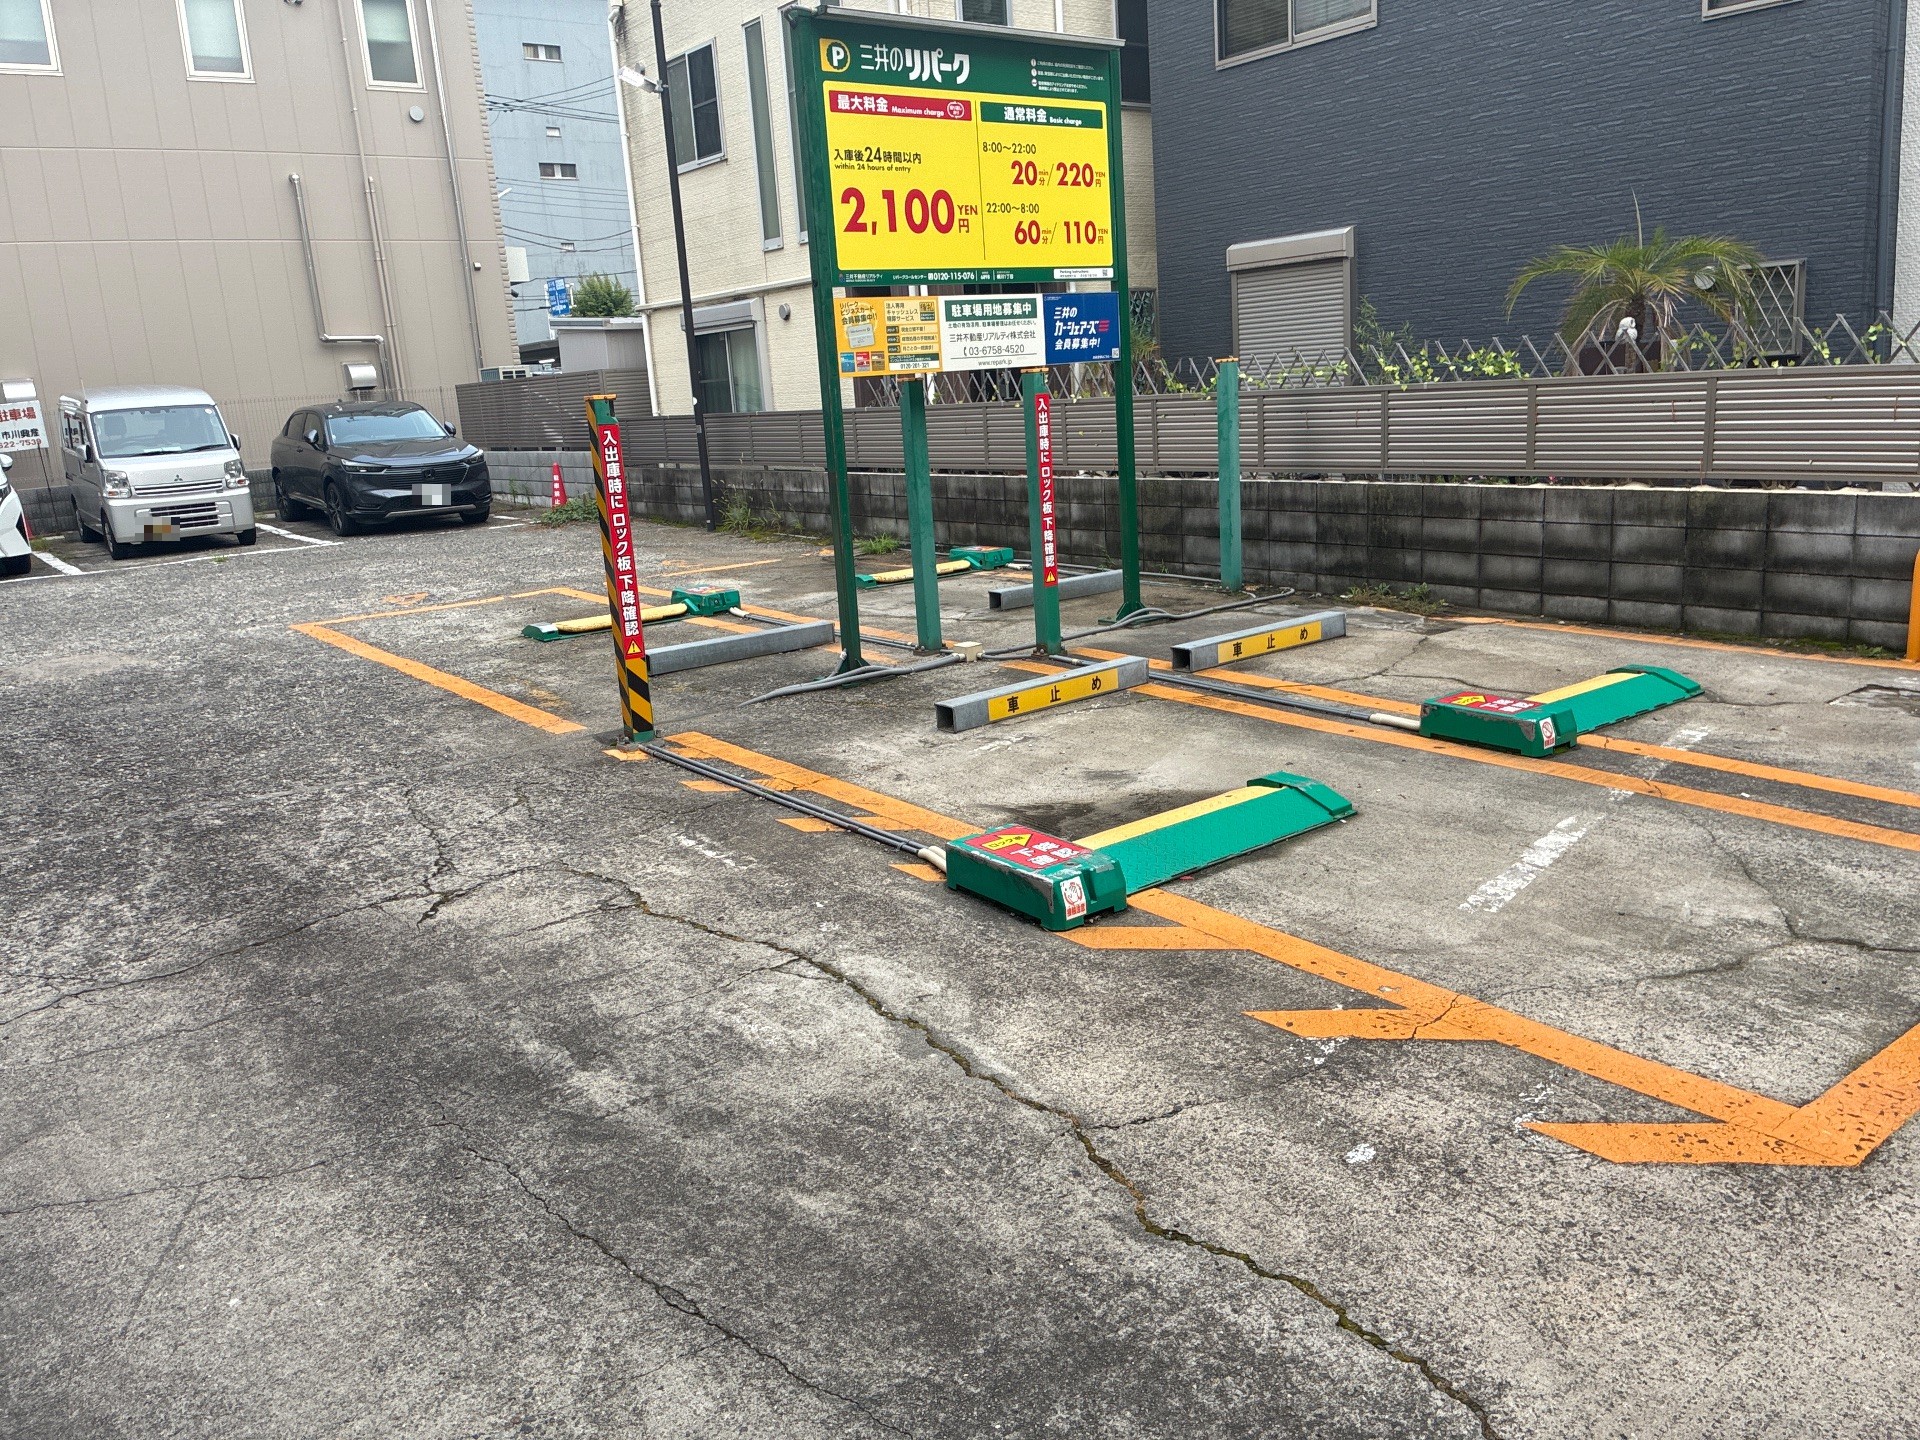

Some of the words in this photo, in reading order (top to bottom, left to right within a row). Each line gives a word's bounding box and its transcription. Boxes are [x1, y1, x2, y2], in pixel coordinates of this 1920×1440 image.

[860, 43, 970, 85] 三井のリパーク
[837, 93, 889, 113] 最大料金
[892, 106, 923, 115] Maximum
[924, 107, 945, 118] charge
[1004, 106, 1047, 123] 通常料金
[1049, 116, 1063, 124] Basic
[1064, 117, 1082, 127] charge
[833, 146, 922, 165] 入庫後24時間以内
[835, 163, 855, 171] within
[857, 163, 866, 171] 24
[867, 164, 885, 172] hours
[887, 164, 894, 172] of
[895, 166, 912, 174] entry
[1011, 159, 1038, 186] 20
[1056, 161, 1095, 188] 220
[840, 187, 955, 236] 2,100
[957, 204, 978, 216] YEN
[958, 218, 970, 234] 円
[1014, 219, 1041, 245] 60
[1063, 220, 1097, 245] 110
[951, 302, 1032, 317] 駐車場用地募集中
[1053, 306, 1078, 320] 三井の
[949, 329, 1036, 343] 三井不動産リアルティ株式会社
[968, 344, 1025, 356] 03-6758-4520
[978, 358, 1013, 367] www.repark.jp
[1, 428, 40, 440] 市川興産
[1232, 627, 1309, 658] 車止め
[1006, 675, 1103, 714] 車止め
